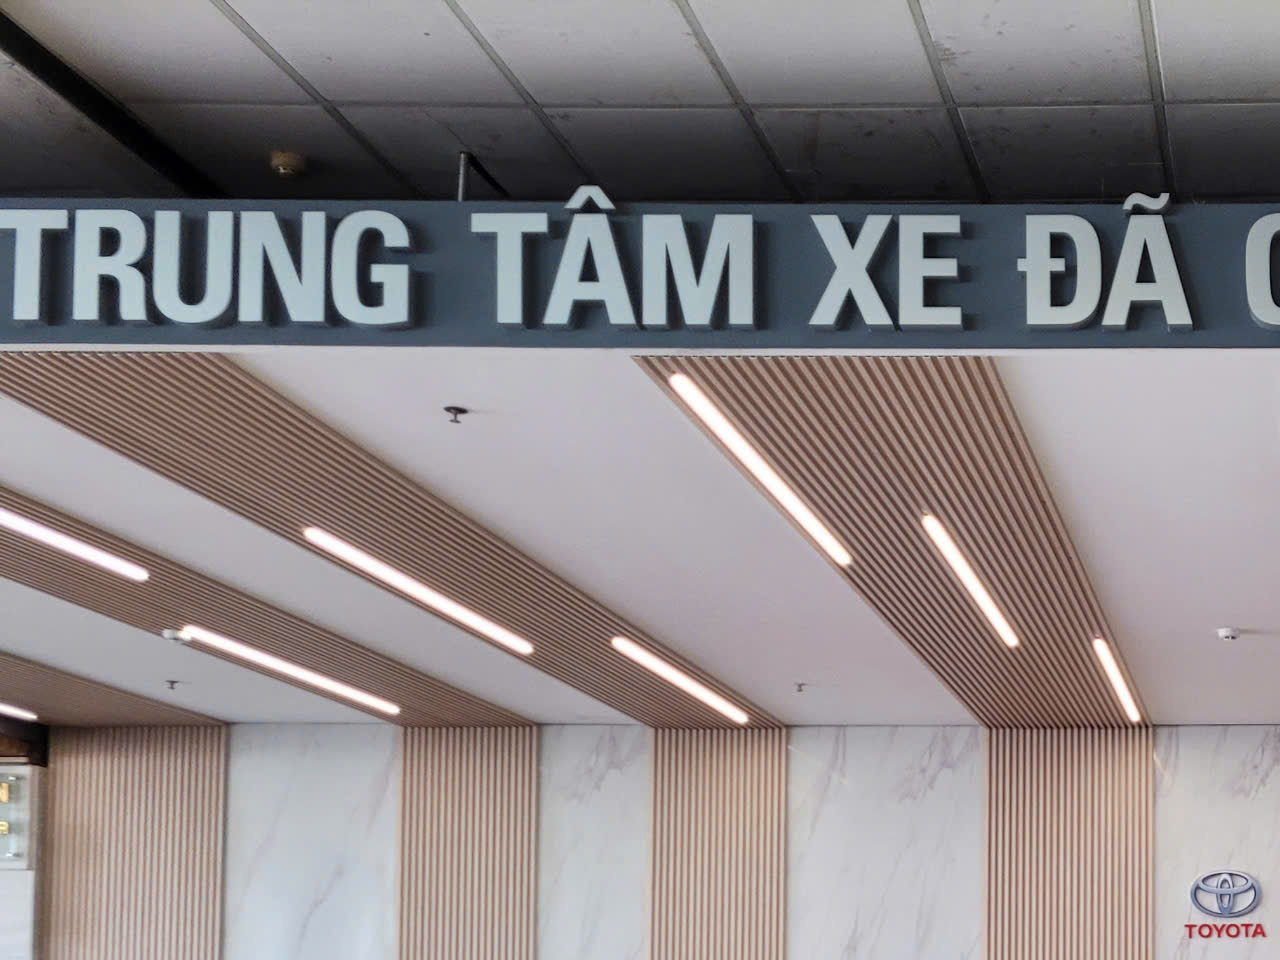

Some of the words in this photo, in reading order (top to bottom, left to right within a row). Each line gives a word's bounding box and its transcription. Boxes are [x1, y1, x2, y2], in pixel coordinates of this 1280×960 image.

[0, 209, 412, 326] TRUNG
[471, 185, 754, 327] TÂM
[809, 213, 963, 328] XE
[1016, 192, 1194, 329] ĐÃ
[1184, 923, 1267, 939] TOYOTA
